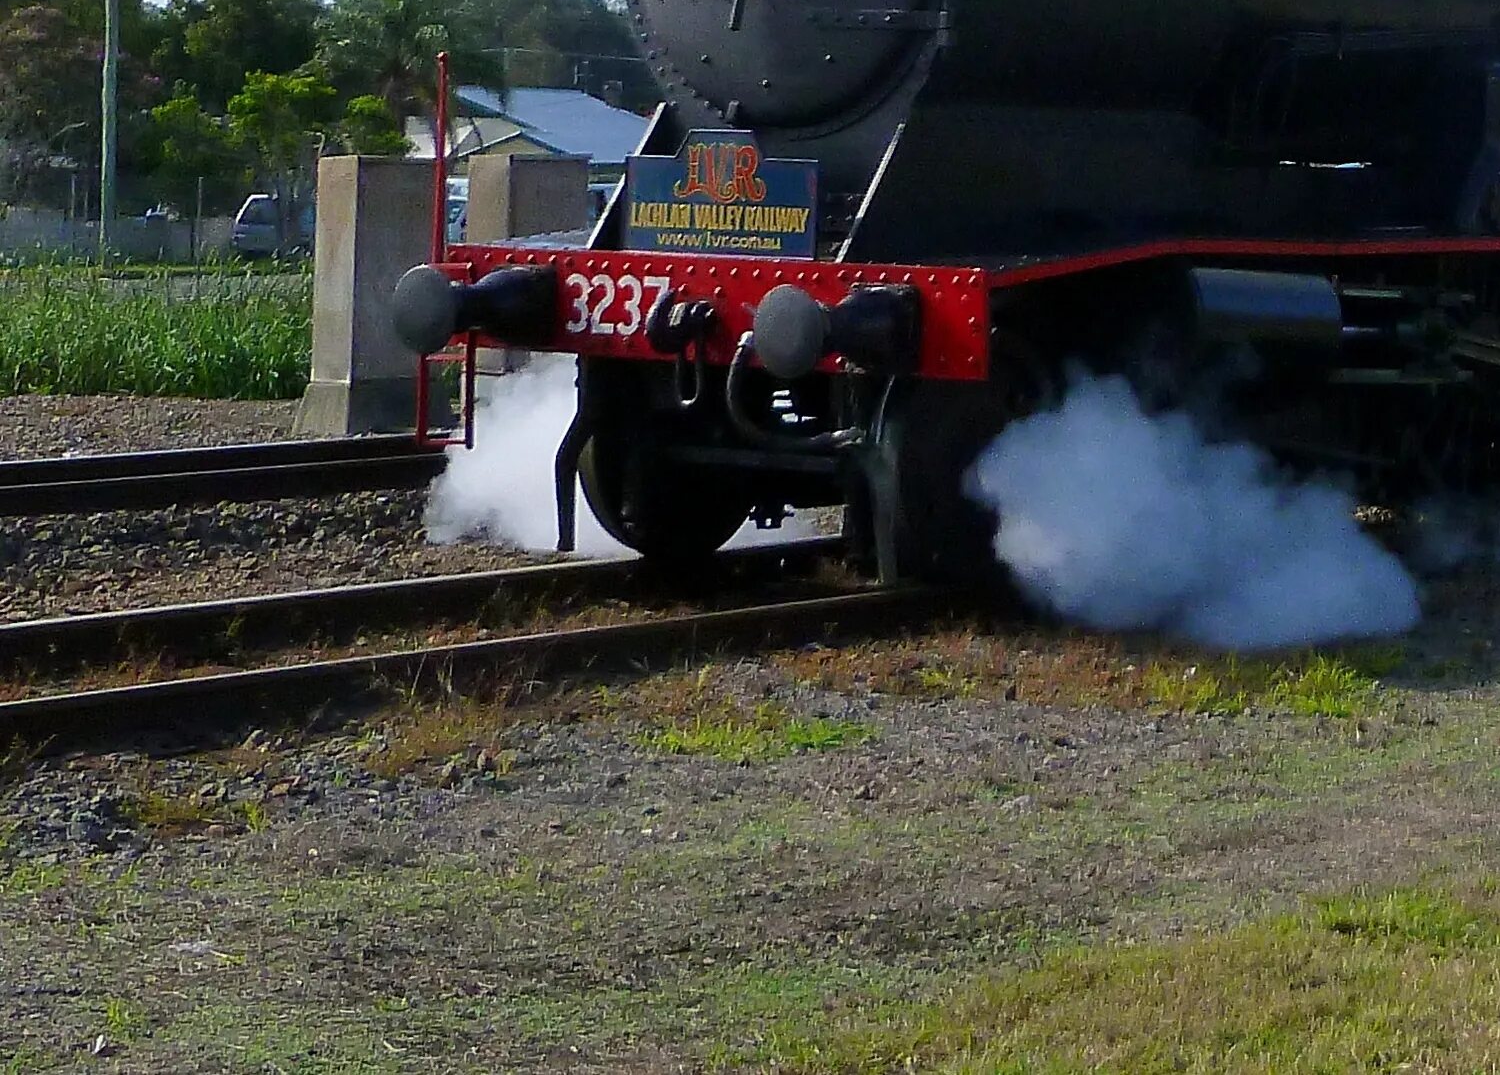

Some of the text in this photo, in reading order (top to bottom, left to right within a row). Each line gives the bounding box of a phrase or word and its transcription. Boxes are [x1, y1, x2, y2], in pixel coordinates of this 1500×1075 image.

[673, 141, 767, 204] LVR
[630, 202, 811, 234] LACHLAN VALLEY RAILWAY
[565, 272, 671, 336] 3237
